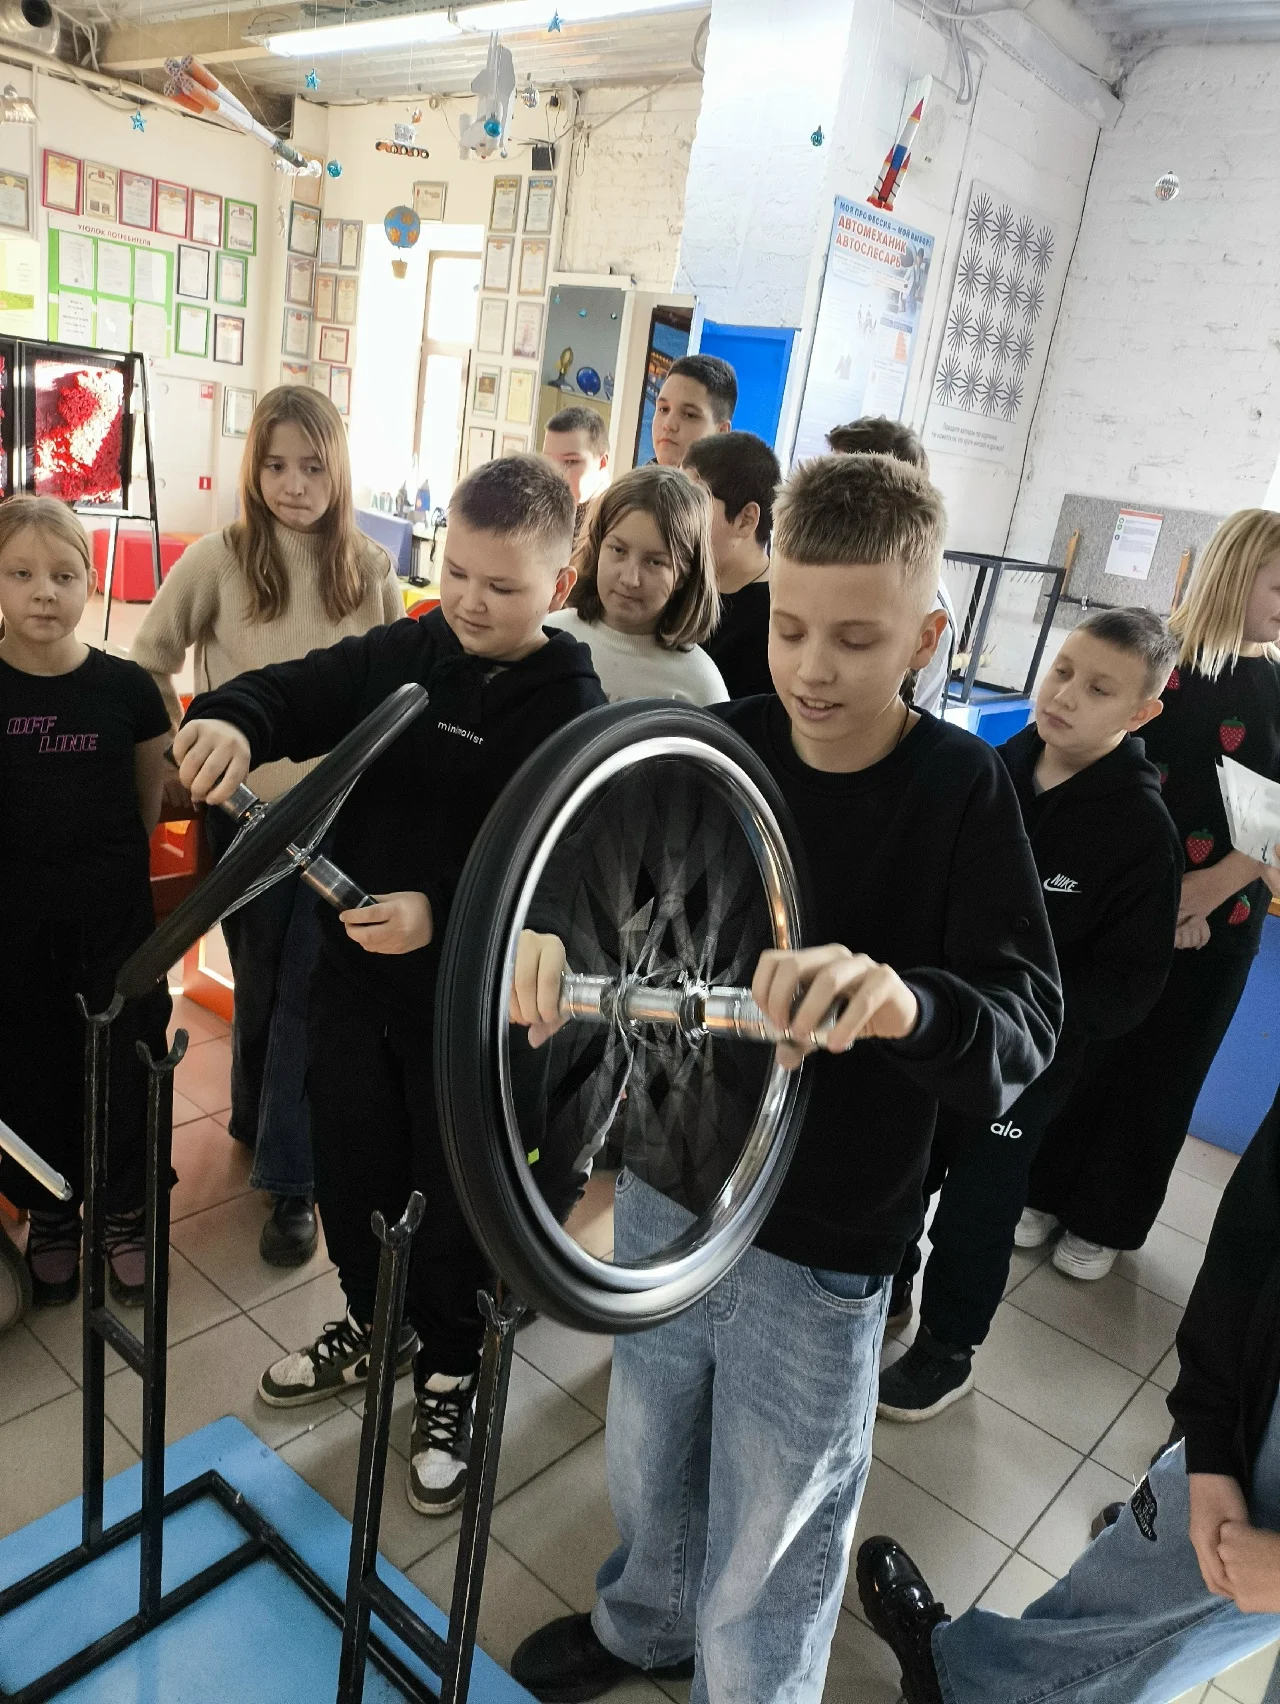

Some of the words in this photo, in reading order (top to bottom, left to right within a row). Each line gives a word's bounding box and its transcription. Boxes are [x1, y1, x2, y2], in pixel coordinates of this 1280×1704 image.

[840, 201, 854, 214] МОЯ
[854, 207, 891, 230] ПРОФЕССИЯ
[897, 226, 910, 239] МОЙ
[78, 224, 105, 235] УГОЛОК
[107, 231, 151, 246] ПОТРЕБИТЕЛЯ
[838, 215, 907, 254] АВТОМЕХАНИК
[836, 232, 901, 268] АВТОСЛЕСАРЬ
[7, 715, 57, 734] OFF
[39, 733, 99, 753] LINE
[1050, 873, 1078, 891] NIKE
[990, 1120, 1023, 1138] alo
